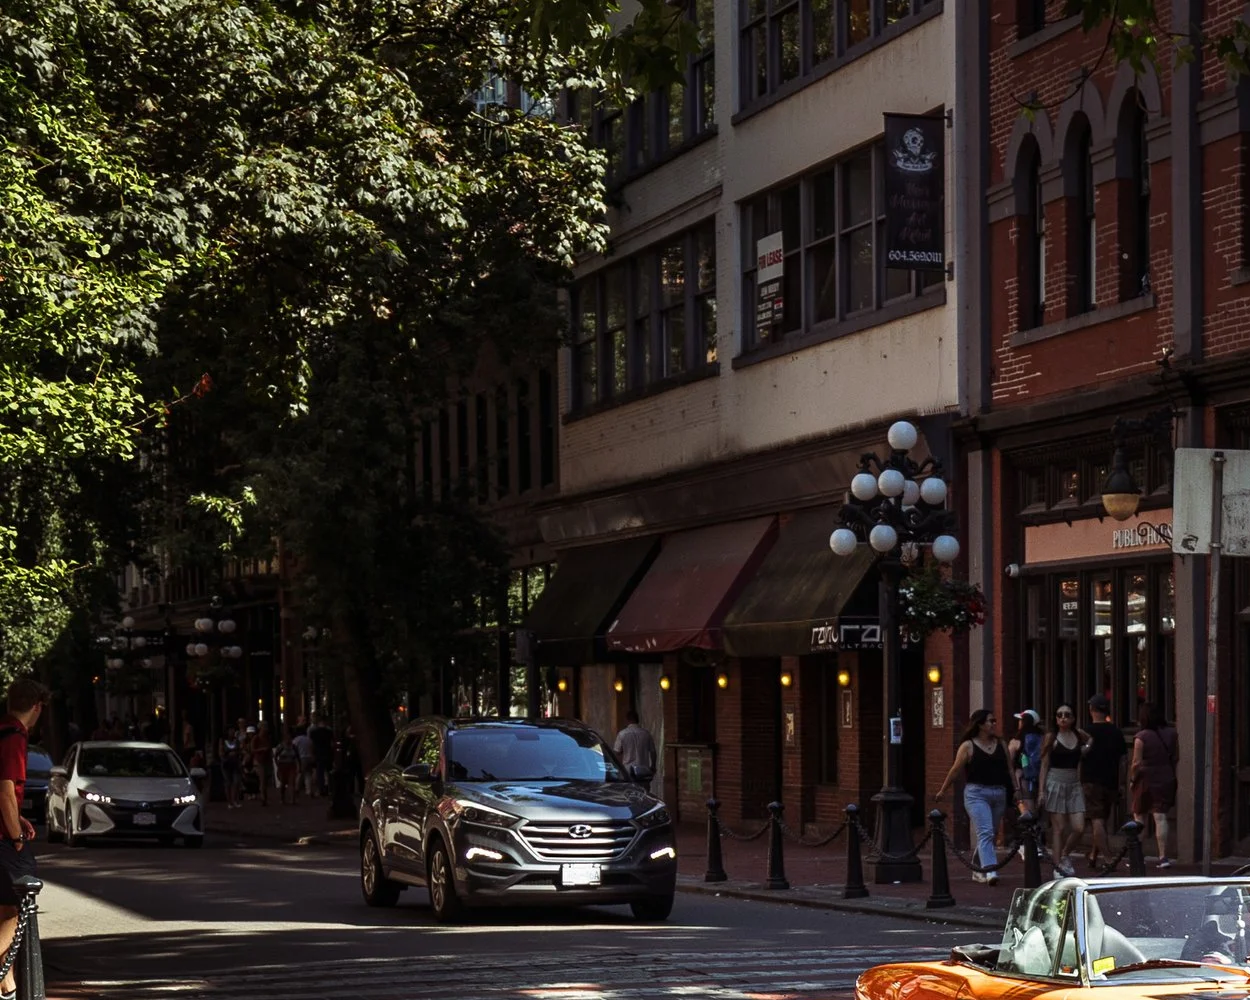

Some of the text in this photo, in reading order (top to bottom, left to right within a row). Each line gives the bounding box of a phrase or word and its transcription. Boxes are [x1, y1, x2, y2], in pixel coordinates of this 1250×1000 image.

[767, 249, 782, 266] LEASE
[1112, 523, 1173, 549] PUBLIC HOUS
